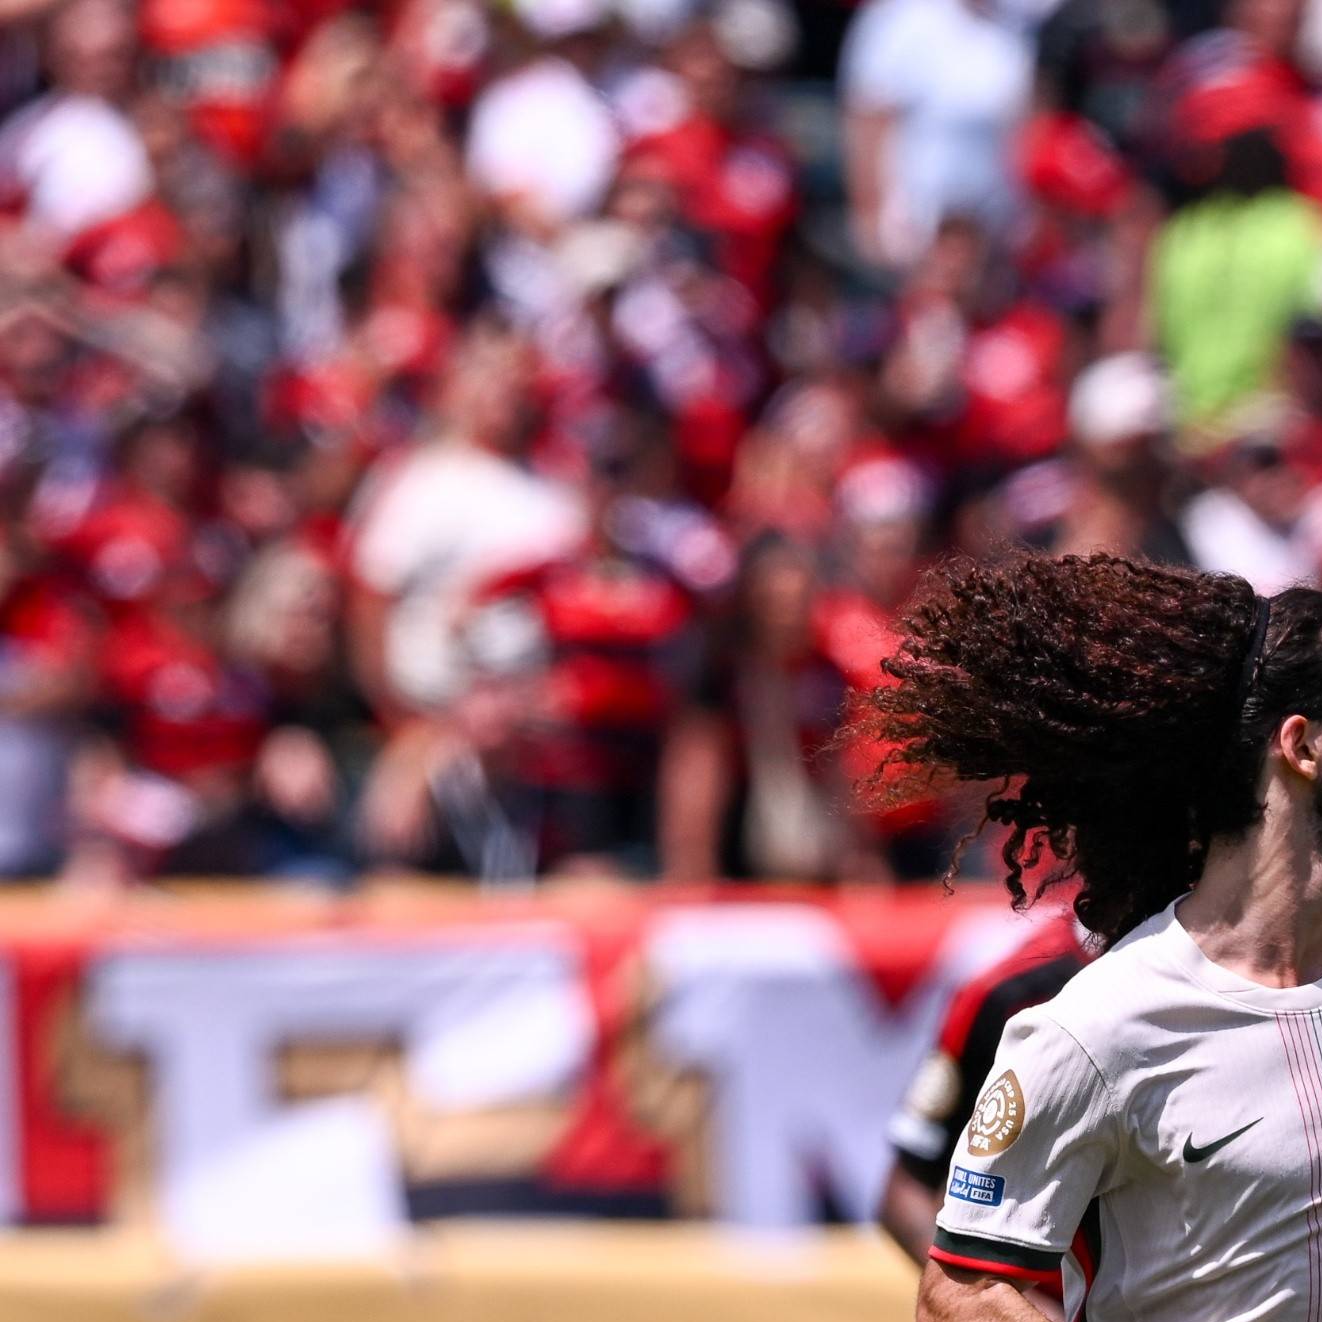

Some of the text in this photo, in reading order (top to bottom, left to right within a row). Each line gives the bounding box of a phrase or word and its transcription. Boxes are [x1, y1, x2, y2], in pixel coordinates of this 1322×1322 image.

[995, 1120, 1014, 1141] USA
[968, 1173, 996, 1189] UNITES
[973, 1190, 991, 1200] FIFA
